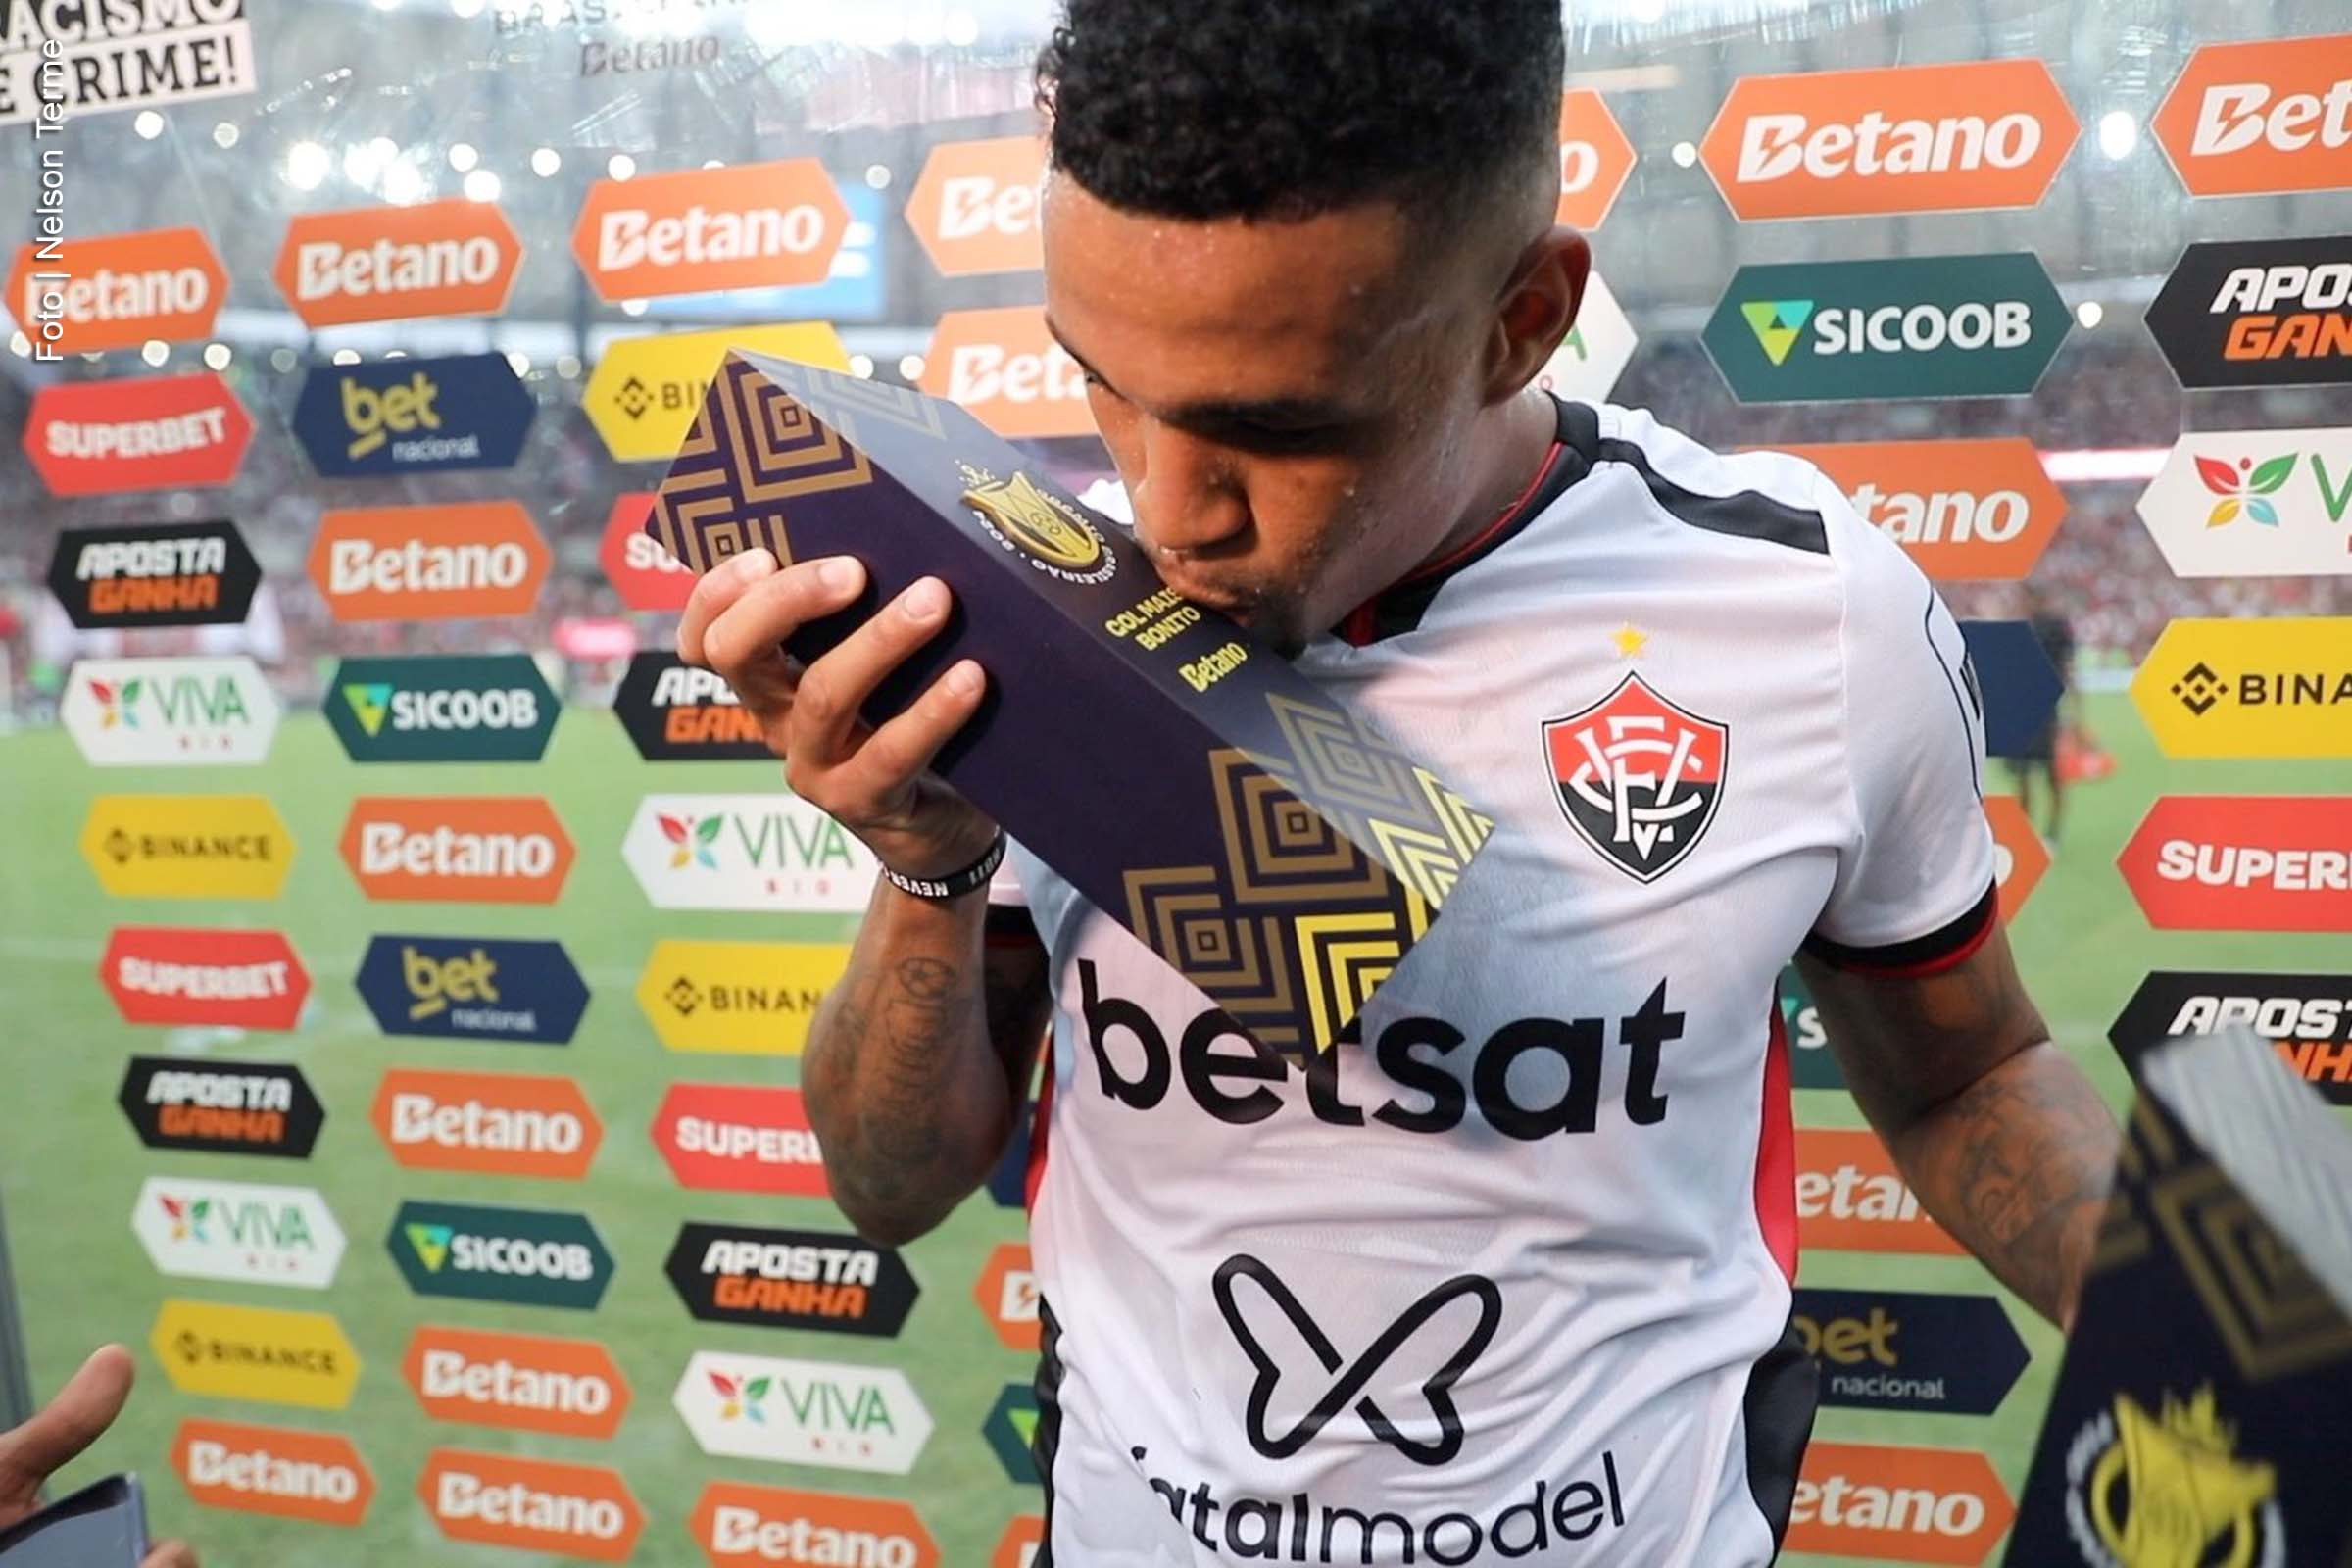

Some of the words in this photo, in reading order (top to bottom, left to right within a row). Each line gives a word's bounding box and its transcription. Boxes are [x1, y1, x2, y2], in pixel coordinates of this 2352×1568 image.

[33, 35, 237, 106] CRIME!
[2190, 78, 2352, 157] Bet
[1737, 112, 2041, 183] Betano
[597, 205, 824, 271] Betano
[298, 236, 499, 302] Betano
[2210, 264, 2352, 314] APO
[25, 267, 209, 322] Betano
[1813, 301, 2031, 356] SICOOB
[2223, 315, 2352, 361] GAN
[341, 372, 440, 431] bet
[47, 407, 226, 458] SUPERBET
[393, 434, 479, 461] nacional
[1851, 482, 2030, 543] tano
[77, 537, 226, 580] APOSTA
[329, 539, 527, 595] Betano
[88, 577, 218, 613] GANHA
[1105, 610, 1148, 637] GOL
[1135, 606, 1201, 651] BONITO
[1179, 642, 1248, 692] Betano
[2238, 672, 2352, 706] BINA
[149, 676, 250, 726] VIVA
[392, 689, 538, 729] SICOOB
[139, 833, 272, 862] BINANCE
[360, 821, 555, 878] Betano
[733, 814, 855, 869] VIVA
[2157, 840, 2352, 890] SUPER
[118, 956, 288, 1000] SUPERBET
[402, 946, 498, 1003] bet
[712, 984, 821, 1014] BINAN
[452, 1008, 536, 1032] nacional
[2167, 996, 2352, 1039] APOS
[1078, 958, 1686, 1141] betsat
[147, 1069, 292, 1111] APOSTA
[158, 1103, 285, 1142] GANHA
[391, 1093, 582, 1153] Betano
[217, 1200, 316, 1251] VIVA
[452, 1241, 593, 1281] SICOOB
[702, 1239, 879, 1286] APOSTA
[714, 1275, 867, 1319] GANHA
[208, 1340, 337, 1375] BINANCE
[422, 1348, 611, 1415] Betano
[781, 1377, 895, 1436] VIVA
[1832, 1374, 1946, 1400] nacional
[188, 1439, 358, 1504] Betano
[437, 1471, 623, 1540] Betano
[1131, 1446, 1624, 1566] talmodel
[1789, 1476, 1984, 1536] etano
[711, 1505, 916, 1568] Betano
